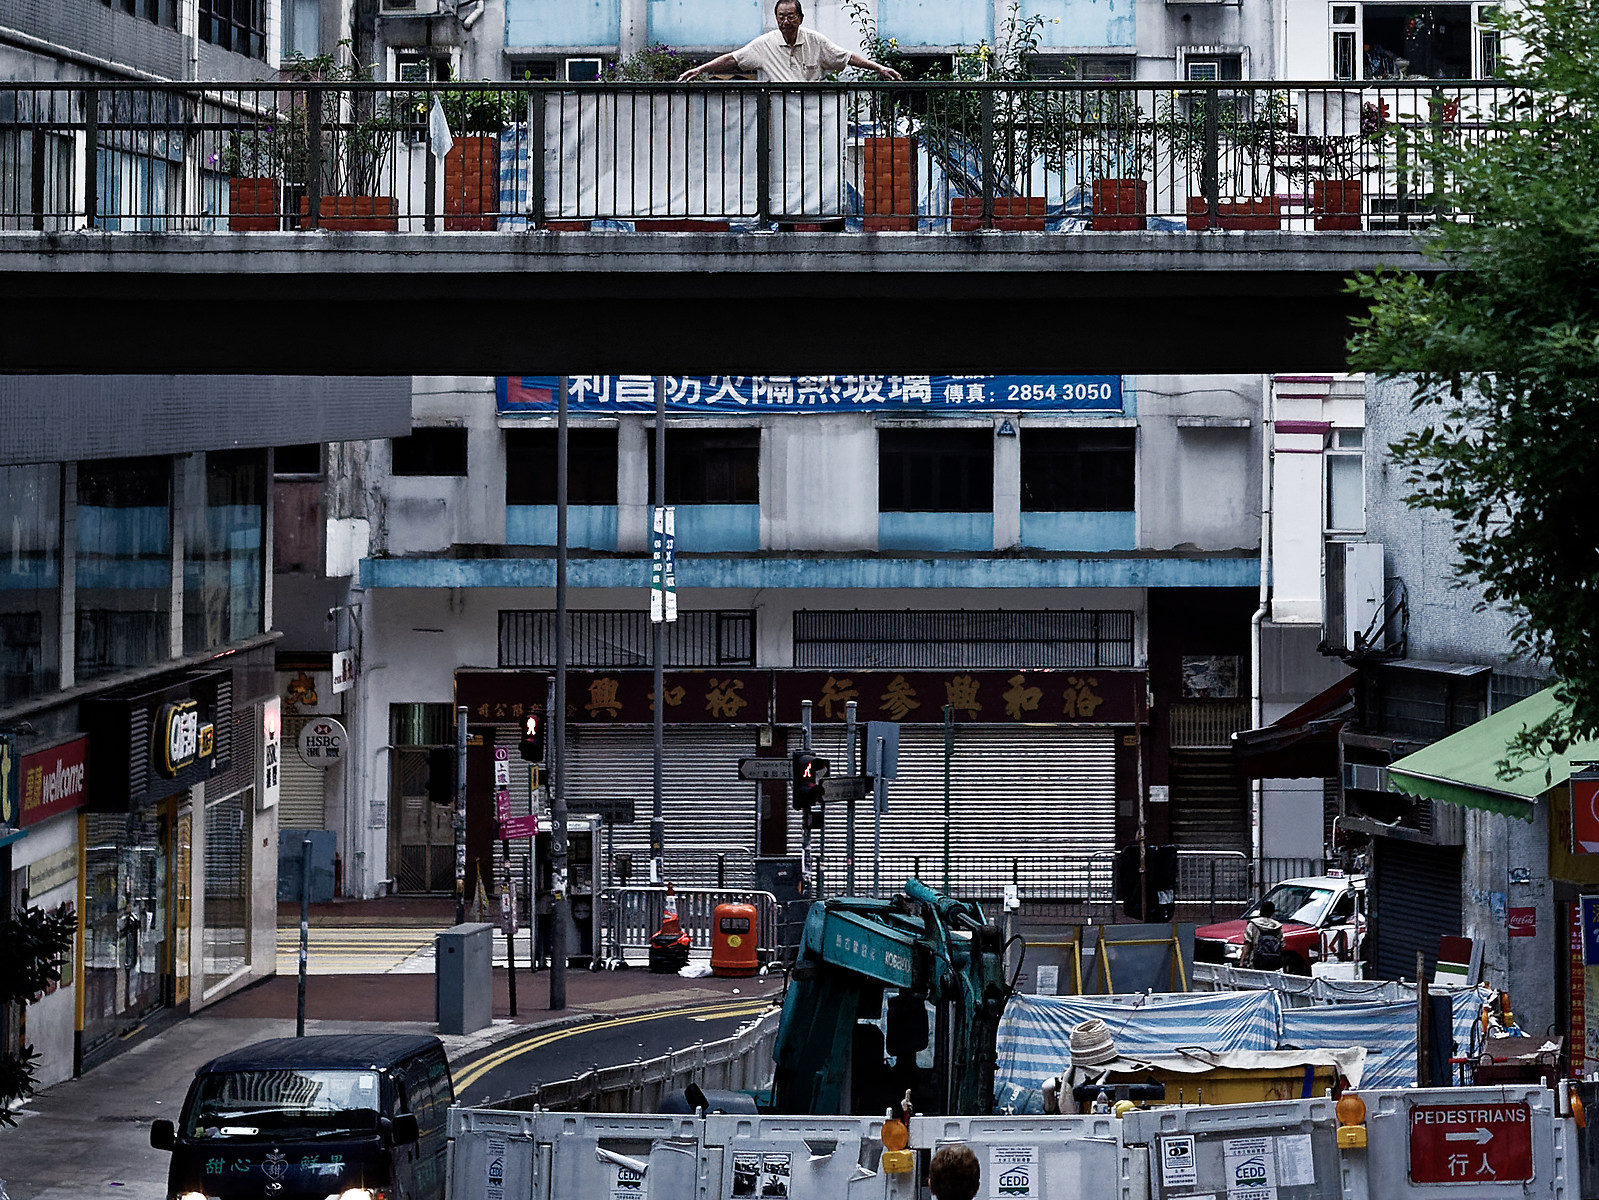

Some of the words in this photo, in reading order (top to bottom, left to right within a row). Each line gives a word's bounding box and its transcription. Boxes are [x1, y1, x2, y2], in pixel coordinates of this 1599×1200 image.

[1007, 384, 1057, 401] 2854
[1062, 383, 1112, 401] 3050
[306, 736, 340, 747] HSBC
[1414, 1108, 1527, 1125] PEDESTRIANS
[204, 1157, 252, 1176] 甜心
[1235, 1166, 1266, 1179] CEDD
[1447, 1153, 1496, 1177] 行人
[617, 1170, 642, 1181] CEDD
[999, 1176, 1029, 1187] CEDD
